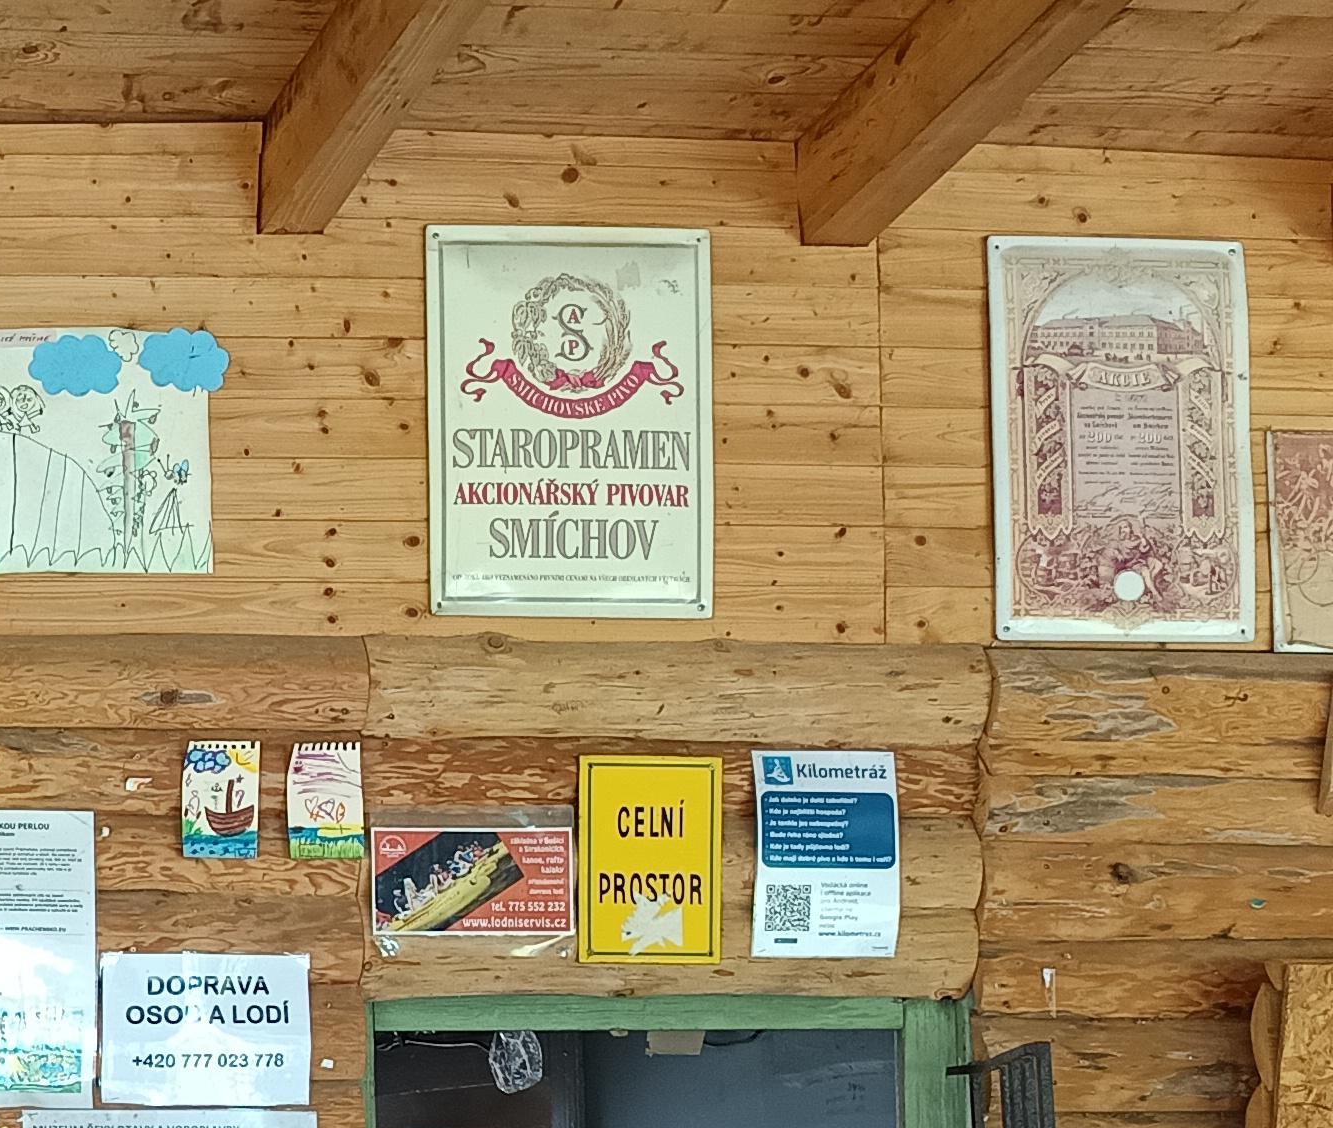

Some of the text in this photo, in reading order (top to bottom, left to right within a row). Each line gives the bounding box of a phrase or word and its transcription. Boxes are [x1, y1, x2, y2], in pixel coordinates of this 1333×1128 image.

[1098, 371, 1151, 386] AKCIE
[610, 373, 640, 408] PIVO
[1087, 431, 1112, 443] 200
[1139, 432, 1162, 444] 200
[452, 428, 691, 472] STAROPRAMEN
[454, 478, 689, 508] AKCIONÁŘSKÝ PIVOVAR
[489, 510, 659, 560] SMÍCHOV
[796, 759, 888, 781] Kilometráž
[617, 799, 685, 838] CELNÍ
[599, 872, 702, 905] PROSTOR
[508, 902, 525, 911] 775
[528, 902, 545, 911] 552
[547, 902, 565, 911] 232
[463, 917, 566, 928] www.lodniservis.cz
[147, 975, 269, 995] DOPRAVA
[209, 1005, 225, 1024] A
[233, 1000, 289, 1024] LODÍ
[132, 1053, 284, 1068] +420 777 023 778
